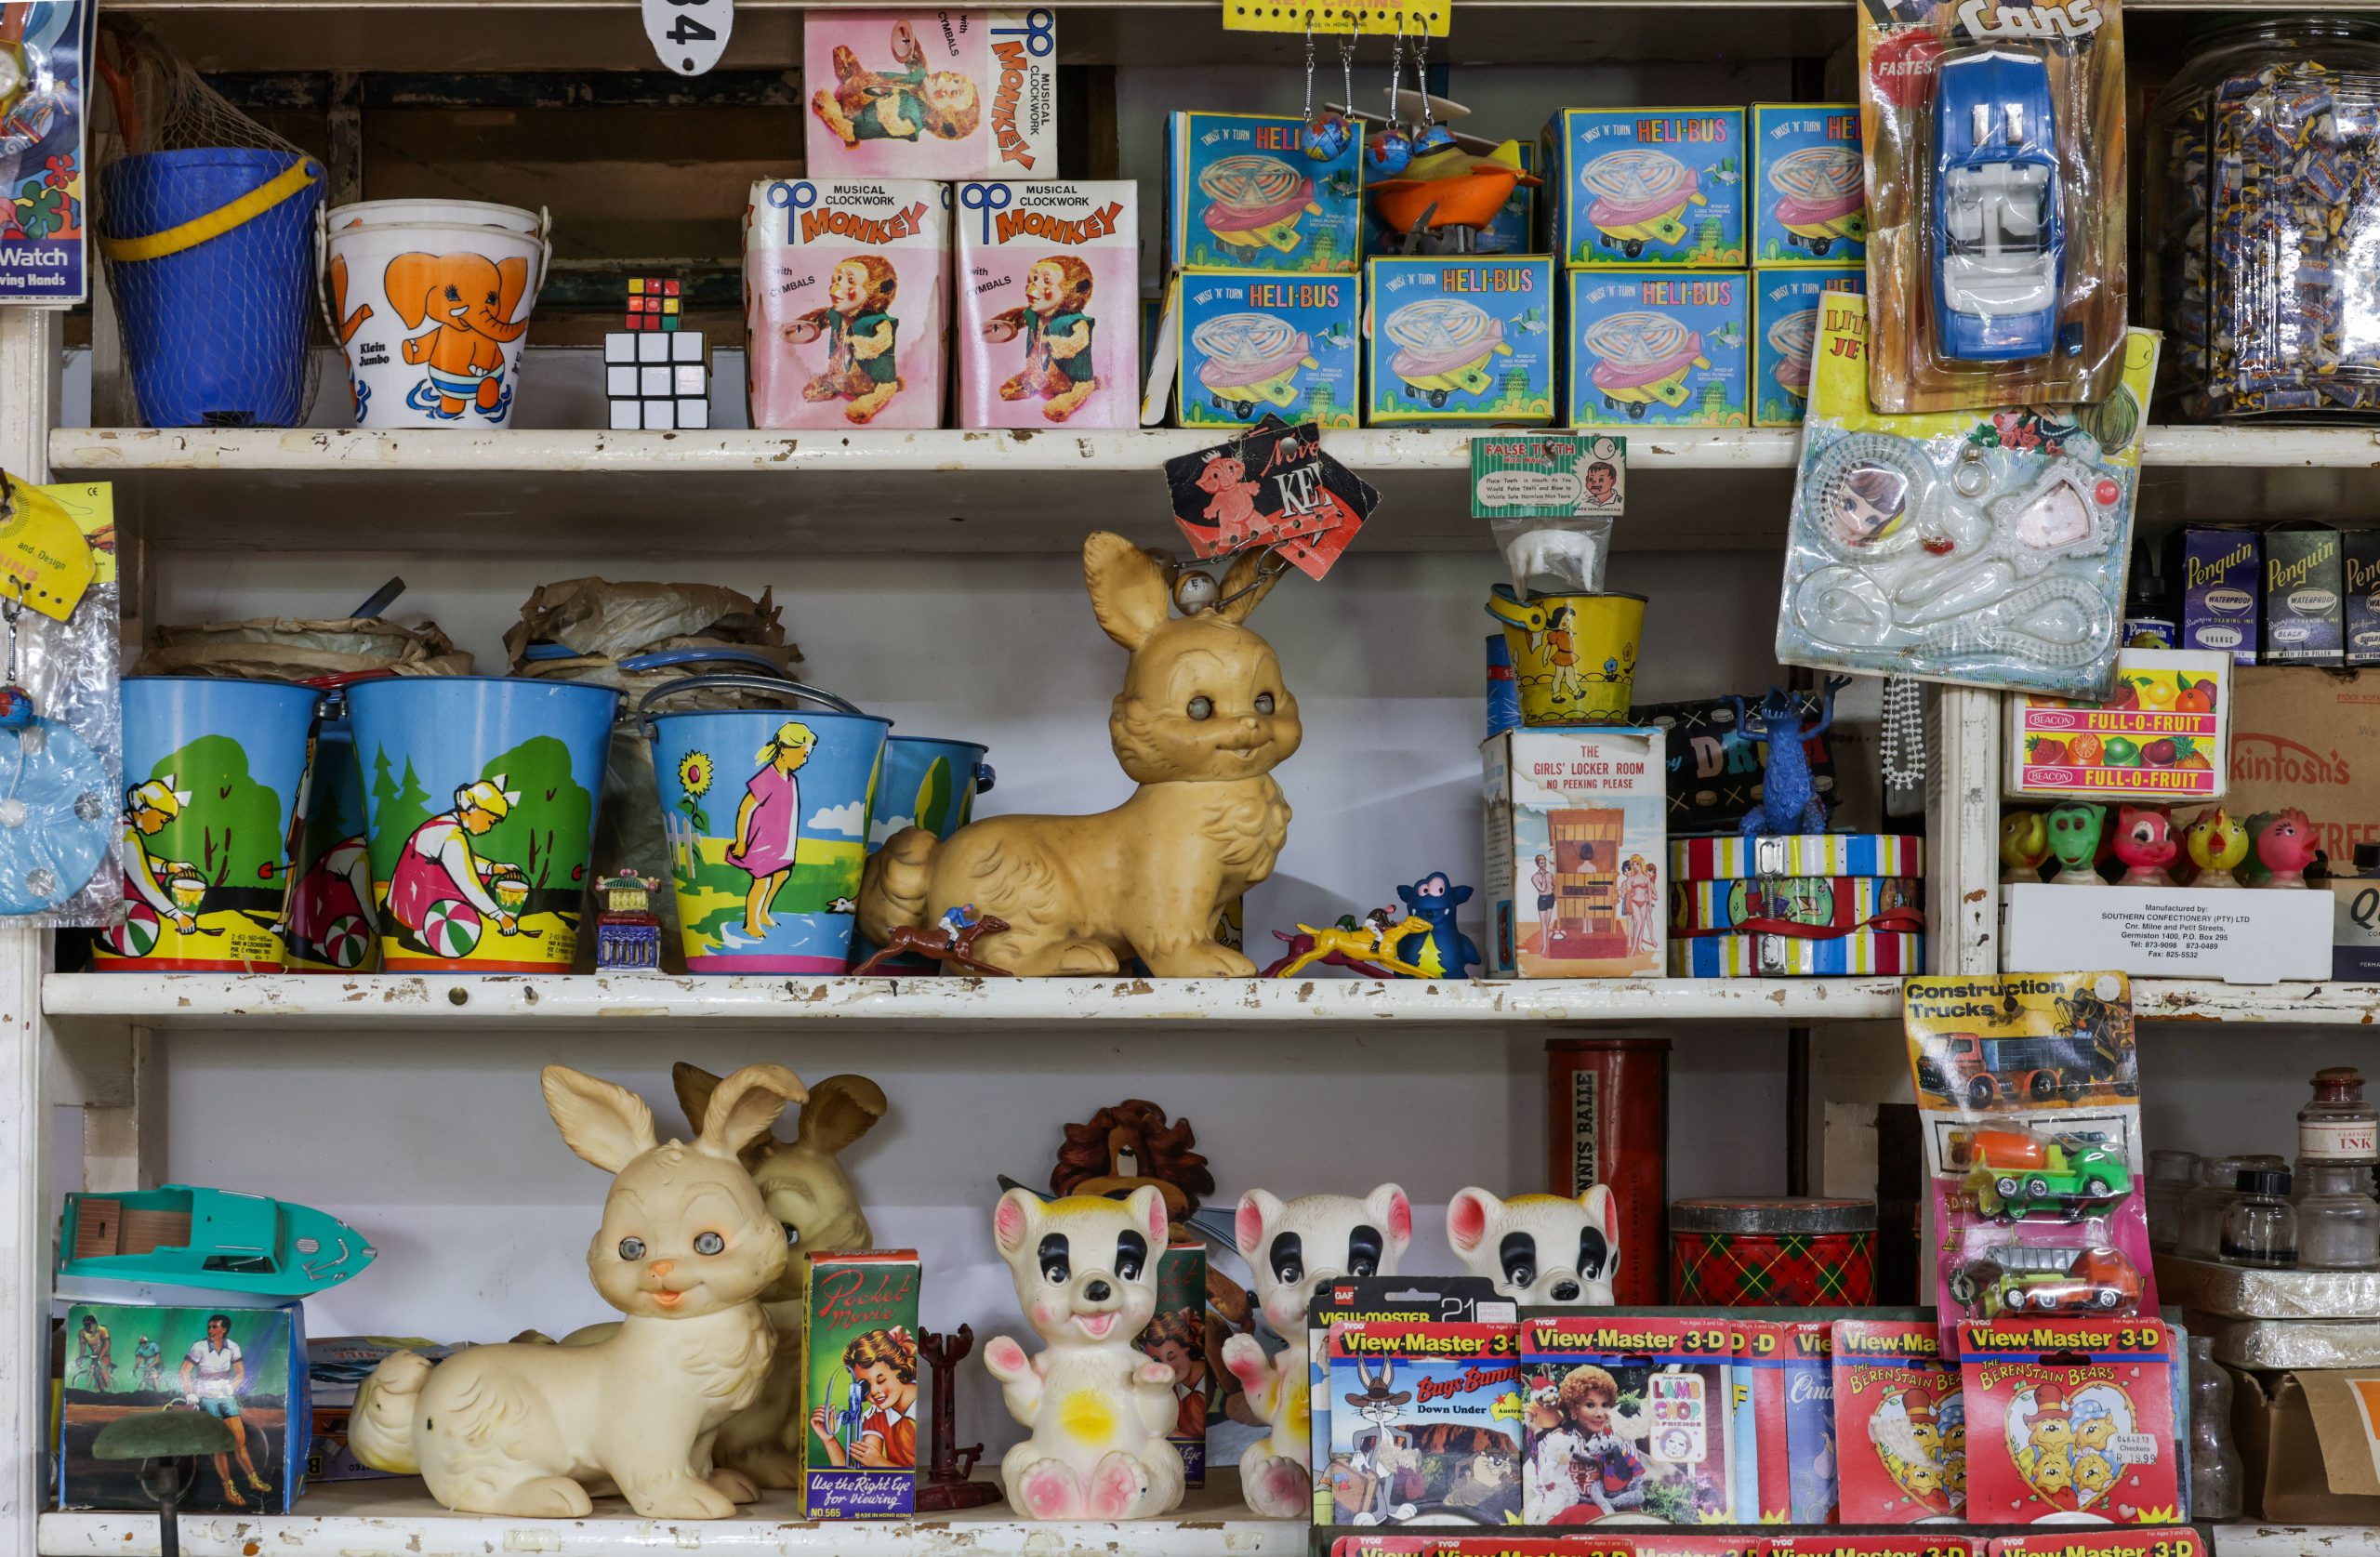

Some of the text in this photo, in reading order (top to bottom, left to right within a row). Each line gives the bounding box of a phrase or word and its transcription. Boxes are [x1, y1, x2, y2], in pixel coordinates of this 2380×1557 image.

[959, 14, 968, 33] with
[938, 11, 959, 57] CYMBALS
[1878, 60, 1935, 76] FASTES
[990, 40, 1036, 171] MONKEY
[1029, 65, 1039, 136] CLOCKWORK
[1040, 73, 1051, 126] MUSICAL
[1200, 129, 1220, 147] TWIST
[1233, 129, 1250, 141] TURN
[1581, 126, 1601, 143] TWIST
[1613, 125, 1631, 136] TURN
[1770, 123, 1790, 139] TWIST
[1804, 120, 1821, 132] TURN
[834, 185, 886, 194] MUSICAL
[1026, 186, 1078, 194] MUSICAL
[826, 196, 894, 205] CLOCKWORK
[1020, 196, 1090, 206] CLOCKWORK
[800, 202, 929, 244] MONKEY
[996, 201, 1124, 244] MONKEY
[0, 247, 68, 267] Watch
[27, 272, 66, 286] Hands
[970, 267, 988, 276] with
[770, 275, 815, 297] CYMBALS
[966, 276, 1012, 297] CYMBALS
[1385, 275, 1406, 293] TWIST
[1418, 273, 1436, 285] TURN
[1193, 288, 1212, 306] TWIST
[1225, 288, 1243, 299] TURN
[1586, 286, 1606, 305] TWIST
[1619, 285, 1635, 297] TURN
[1769, 284, 1789, 302] TWIST
[1802, 283, 1820, 295] TURN
[1825, 310, 1868, 335] LIT
[360, 343, 386, 354] Klein
[359, 356, 390, 367] Jumbo
[1486, 443, 1576, 455] FALSE TTH
[18, 542, 66, 571] and Design
[2187, 542, 2252, 590] Penguin
[2268, 541, 2334, 593] Penguin
[2208, 596, 2252, 604] WATERPROOF
[2291, 596, 2335, 604] WATERPROOF
[2278, 629, 2303, 638] BLACK
[2279, 650, 2294, 658] WITH
[2032, 713, 2202, 732] BEACON FULL-O-FRUIT
[1580, 746, 1600, 759] THE
[1534, 762, 1645, 775] GIRLS' LOCKER ROOM
[1547, 779, 1633, 789] NO PEEKING PLEASE
[2031, 770, 2199, 789] BEACON FULL-O-FRUIT
[2101, 912, 2144, 921] SOUTHERN
[2147, 914, 2211, 923] CONFECTIONERY
[2214, 915, 2234, 924] (PTY)
[2145, 904, 2209, 915] Manufactured by:
[2121, 931, 2160, 940] Germiston
[2199, 924, 2226, 933] Streets,
[2145, 941, 2177, 949] 873-9098
[2186, 942, 2218, 950] 873-0489
[1906, 980, 2066, 999] Construction
[1909, 1002, 1996, 1019] Trucks
[1576, 1073, 1593, 1195] NNIS BALLE
[2340, 1138, 2372, 1150] INK
[818, 1268, 911, 1318] Pocket
[1335, 1291, 1355, 1300] GAF
[1442, 1297, 1474, 1323] 21
[1534, 1318, 1557, 1326] TYCO
[1345, 1332, 1485, 1351] View-Master
[1536, 1328, 1678, 1348] View-Master
[1687, 1330, 1726, 1349] 3-D
[1972, 1328, 2160, 1347] View-Master 3-D
[1853, 1363, 1870, 1374] THE
[1982, 1358, 2000, 1370] THE
[1849, 1367, 1933, 1394] BERENSTAIN
[1979, 1364, 2116, 1392] BERENSTAIN BEARS
[1416, 1375, 1464, 1404] Bugs
[1652, 1379, 1701, 1399] LAMB
[1417, 1405, 1487, 1414] Down Under
[1653, 1401, 1701, 1420] CHOP
[2119, 1445, 2151, 1453] Checkers
[2116, 1454, 2157, 1465] R 19.99
[811, 1474, 911, 1496] Use the Right Eye
[824, 1489, 903, 1511] for viewing
[811, 1508, 840, 1518] NO.565
